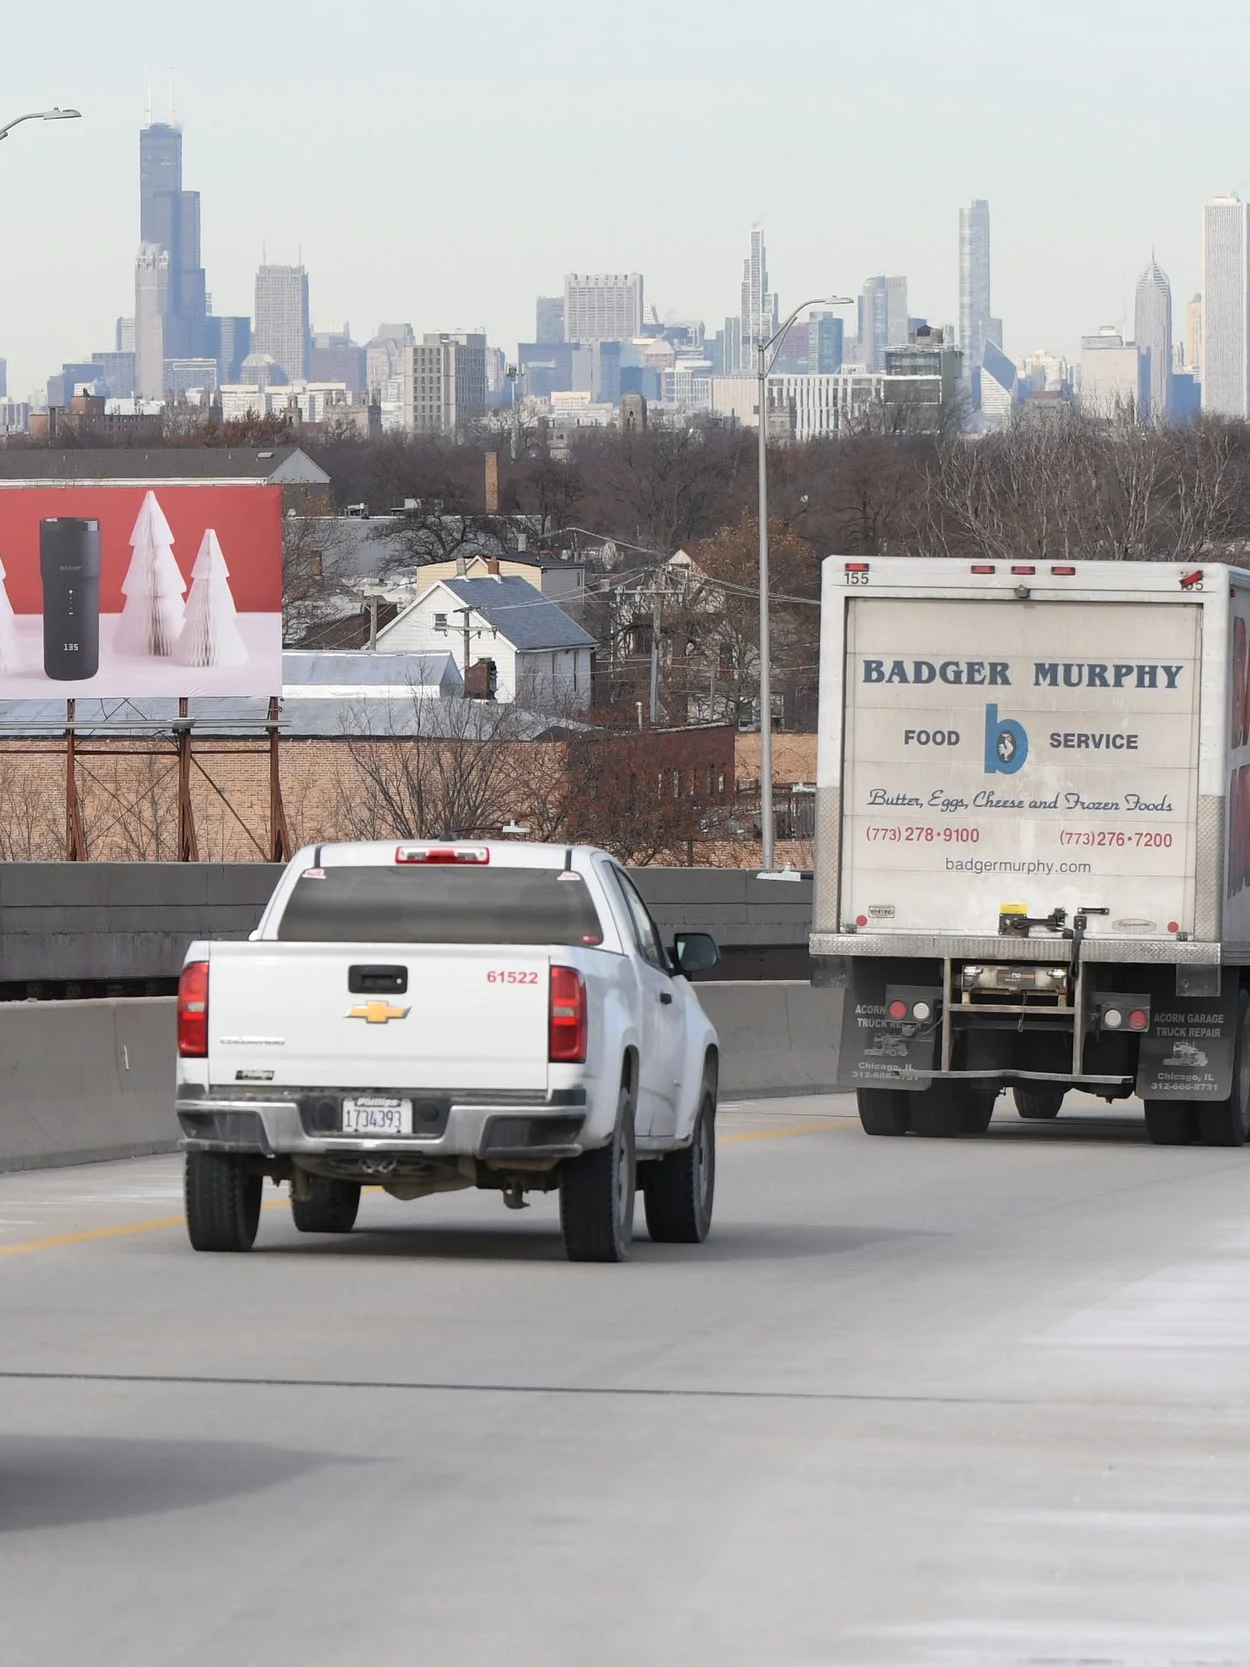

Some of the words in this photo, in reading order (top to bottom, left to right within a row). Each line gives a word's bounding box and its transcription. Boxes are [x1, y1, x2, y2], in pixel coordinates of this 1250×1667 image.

[844, 572, 869, 585] 155
[63, 643, 79, 651] 135
[862, 660, 1012, 685] BADGER
[1033, 662, 1184, 689] MURPHY
[904, 730, 960, 746] FOOD
[1049, 732, 1139, 750] SERVICE
[867, 788, 923, 808] Butter,
[928, 789, 968, 812] Eggs,
[972, 790, 1025, 809] Cheese
[1028, 792, 1061, 810] and
[1064, 792, 1120, 811] Frozen
[1124, 793, 1174, 812] Foods
[866, 826, 901, 842] (773)
[1059, 830, 1095, 846] (773)
[945, 858, 1091, 876] badgermurphy.com
[487, 970, 538, 984] 61522
[855, 1004, 886, 1014] ACORN
[857, 1018, 888, 1028] TRUCK
[1154, 1013, 1185, 1022] ACORN
[1187, 1014, 1225, 1023] GARAGE
[1156, 1027, 1186, 1037] TRUCK
[1188, 1028, 1221, 1037] REPAIR
[1157, 1072, 1202, 1082] Chicago,
[345, 1110, 402, 1128] 1734393
